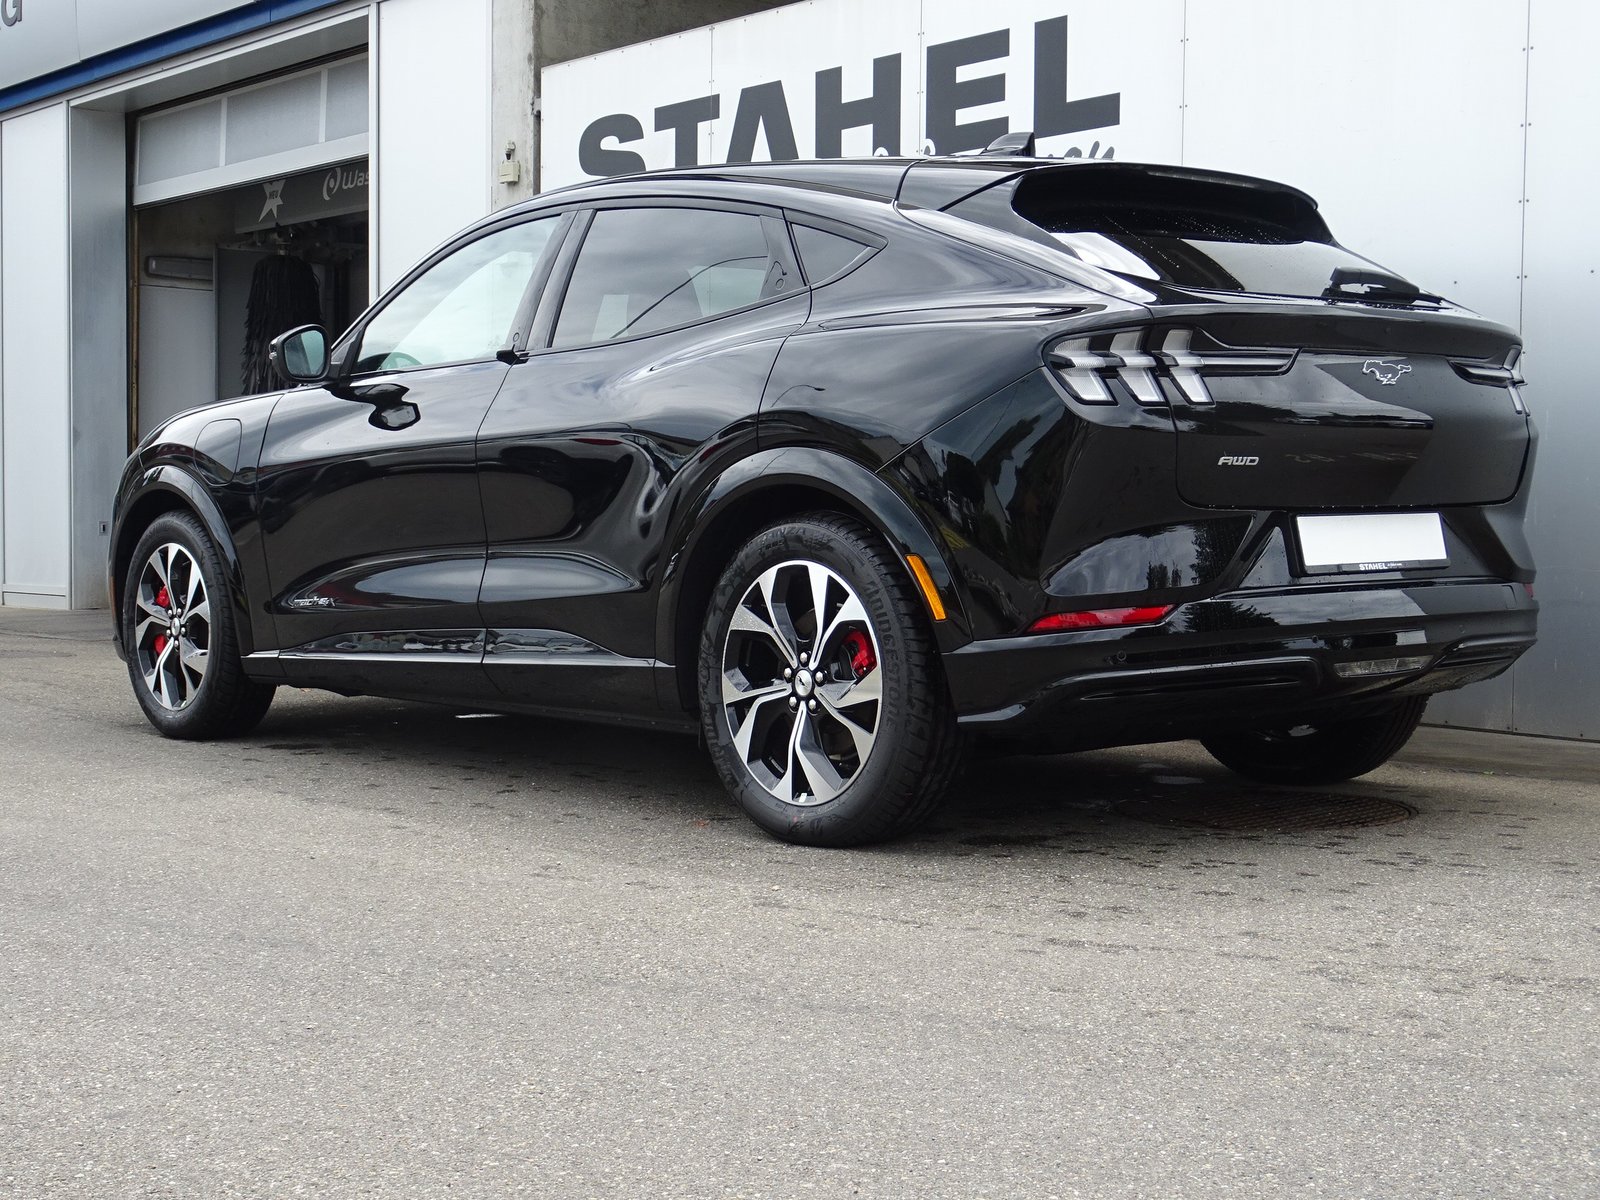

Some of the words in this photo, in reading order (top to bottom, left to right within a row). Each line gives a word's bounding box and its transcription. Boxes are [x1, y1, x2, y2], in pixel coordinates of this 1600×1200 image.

[578, 15, 1120, 177] STAHEL
[1217, 456, 1260, 466] AWD
[1359, 563, 1388, 571] STAHEL
